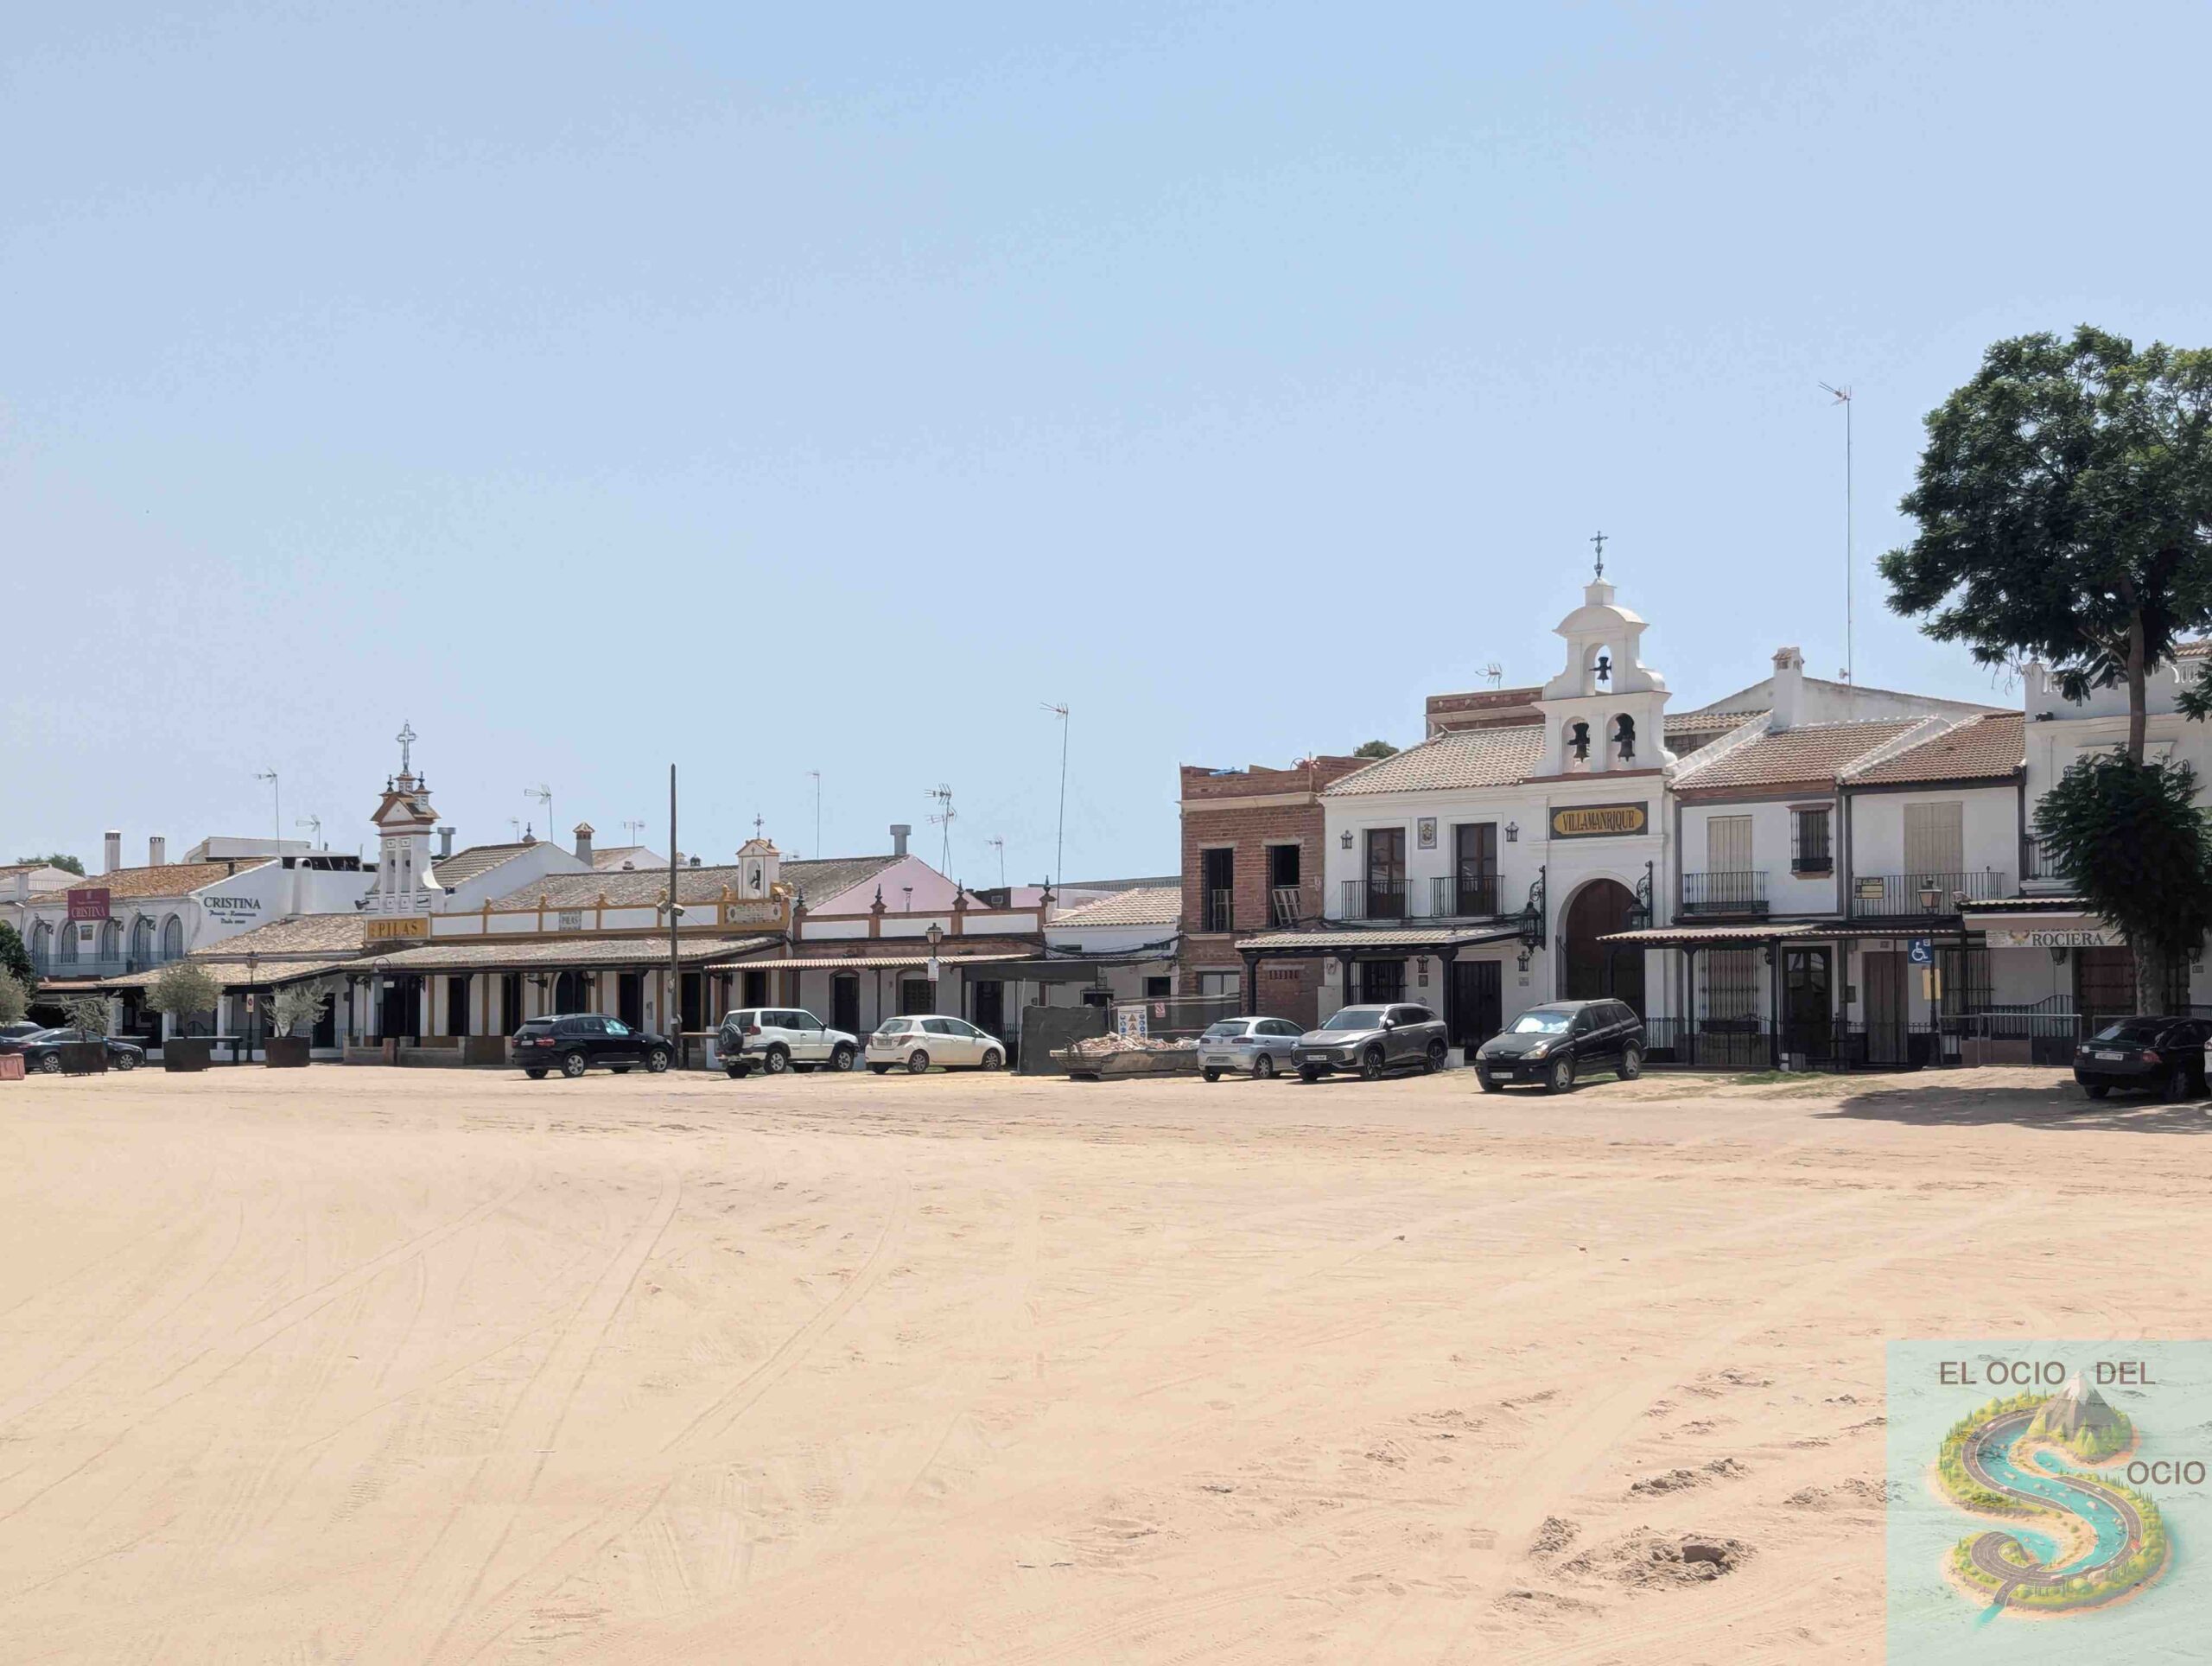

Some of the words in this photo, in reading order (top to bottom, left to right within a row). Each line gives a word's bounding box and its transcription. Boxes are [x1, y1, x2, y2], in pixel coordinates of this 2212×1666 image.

[1562, 810, 1636, 831] VILLAMANRIQUE
[203, 897, 262, 910] CRISTINA
[71, 906, 106, 919] CRISTINA
[378, 921, 418, 937] PILAS
[2032, 932, 2105, 947] ROCIERA
